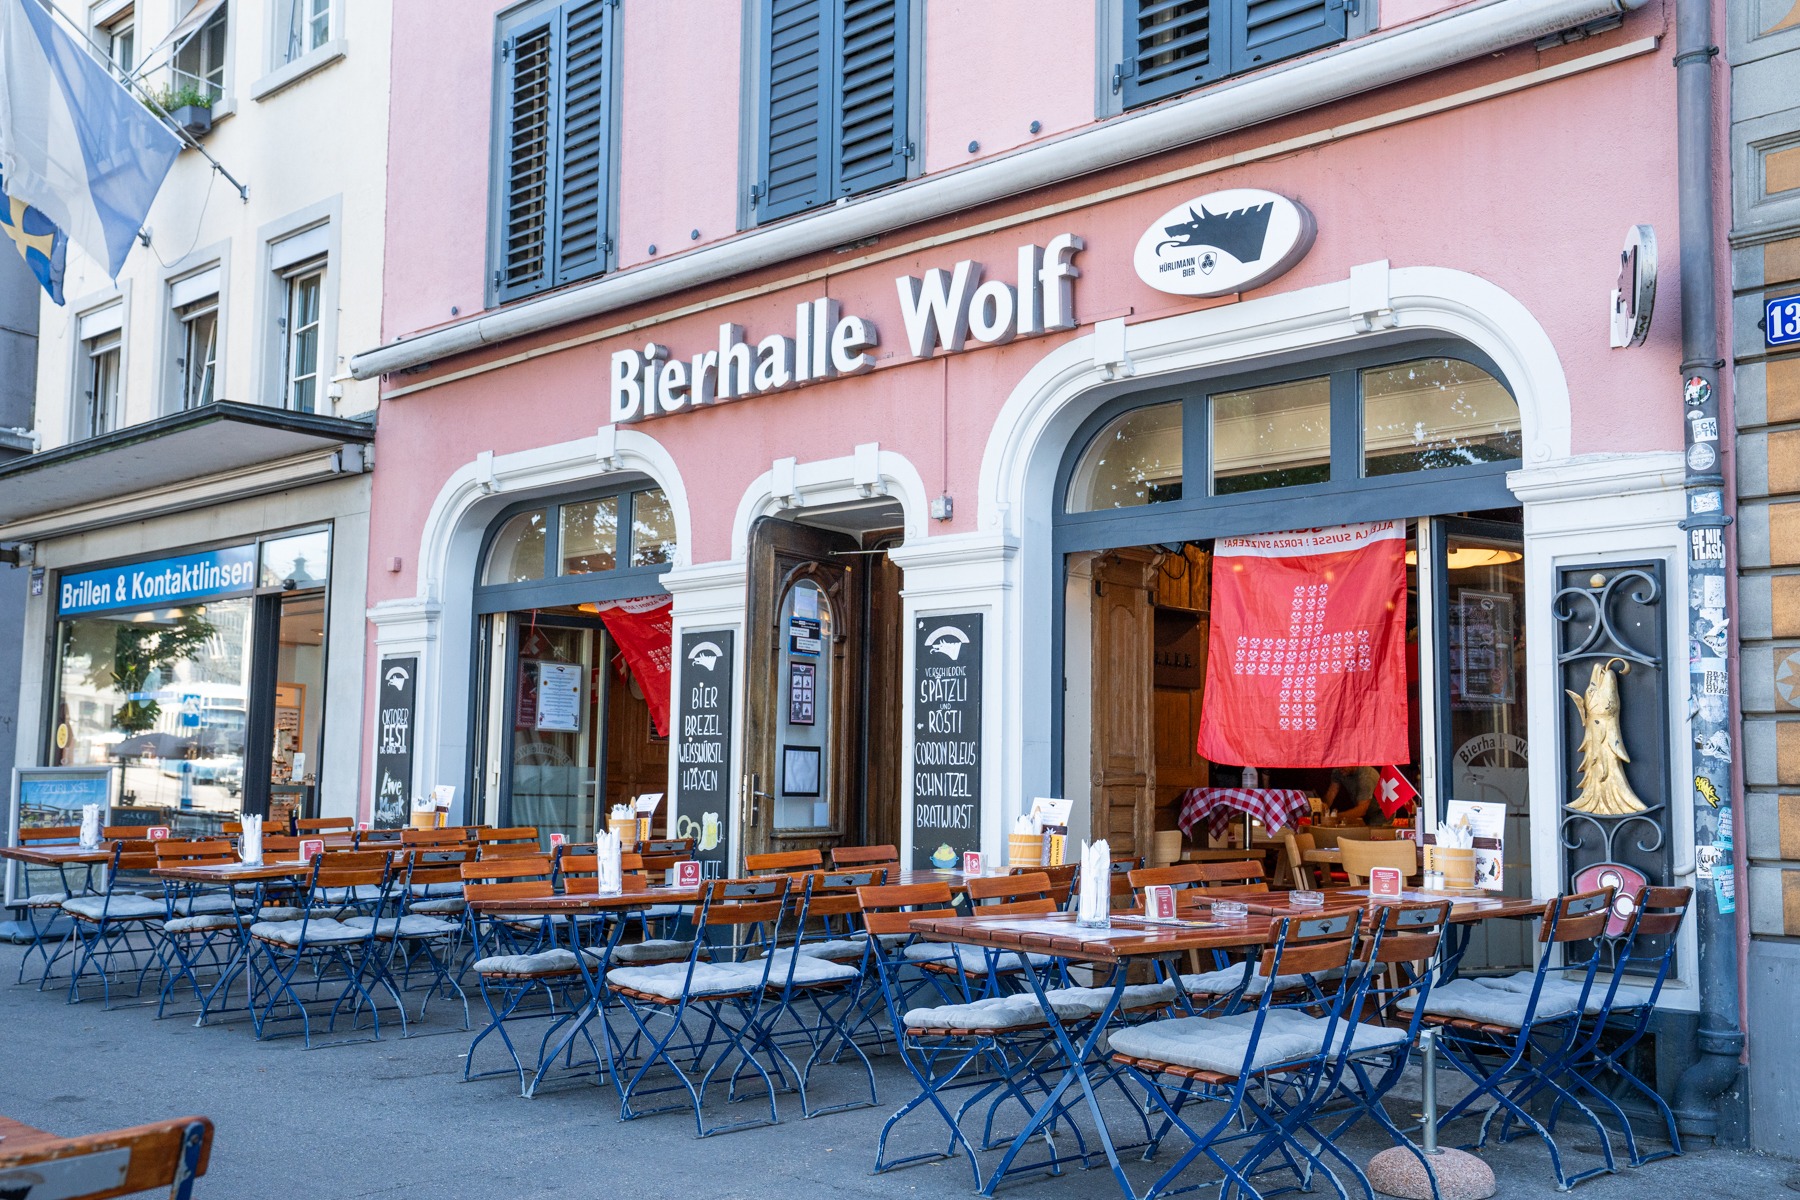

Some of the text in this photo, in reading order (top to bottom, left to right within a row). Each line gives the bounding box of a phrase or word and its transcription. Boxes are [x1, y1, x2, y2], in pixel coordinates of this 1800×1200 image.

[1159, 257, 1196, 273] HÜRLIMANN
[1182, 267, 1196, 277] BIER
[611, 233, 1083, 423] Bierhalle Wolf
[1770, 302, 1800, 338] 13
[1694, 421, 1716, 431] FCK
[1695, 429, 1717, 438] PTN
[1692, 528, 1721, 545] GENIE
[1692, 542, 1722, 560] TEASE
[62, 579, 110, 609] Brillen
[115, 574, 127, 602] &
[131, 560, 253, 599] Kontaktlinsen
[925, 666, 967, 677] VERSCHIEDENE
[691, 682, 718, 709] BIER
[920, 676, 967, 703] SPÄTZLI
[382, 708, 409, 725] OKTOBER
[685, 715, 722, 737] BREZEL
[929, 710, 961, 733] RÖSTI
[383, 724, 408, 747] FEST
[679, 738, 723, 763] WEISSWÜRSTL
[916, 741, 976, 765] CORDON BLEUS
[381, 772, 402, 796] Live
[683, 767, 718, 791] HÄXEN
[916, 772, 972, 797] SCHNITZEL
[916, 804, 974, 829] BRATWURST
